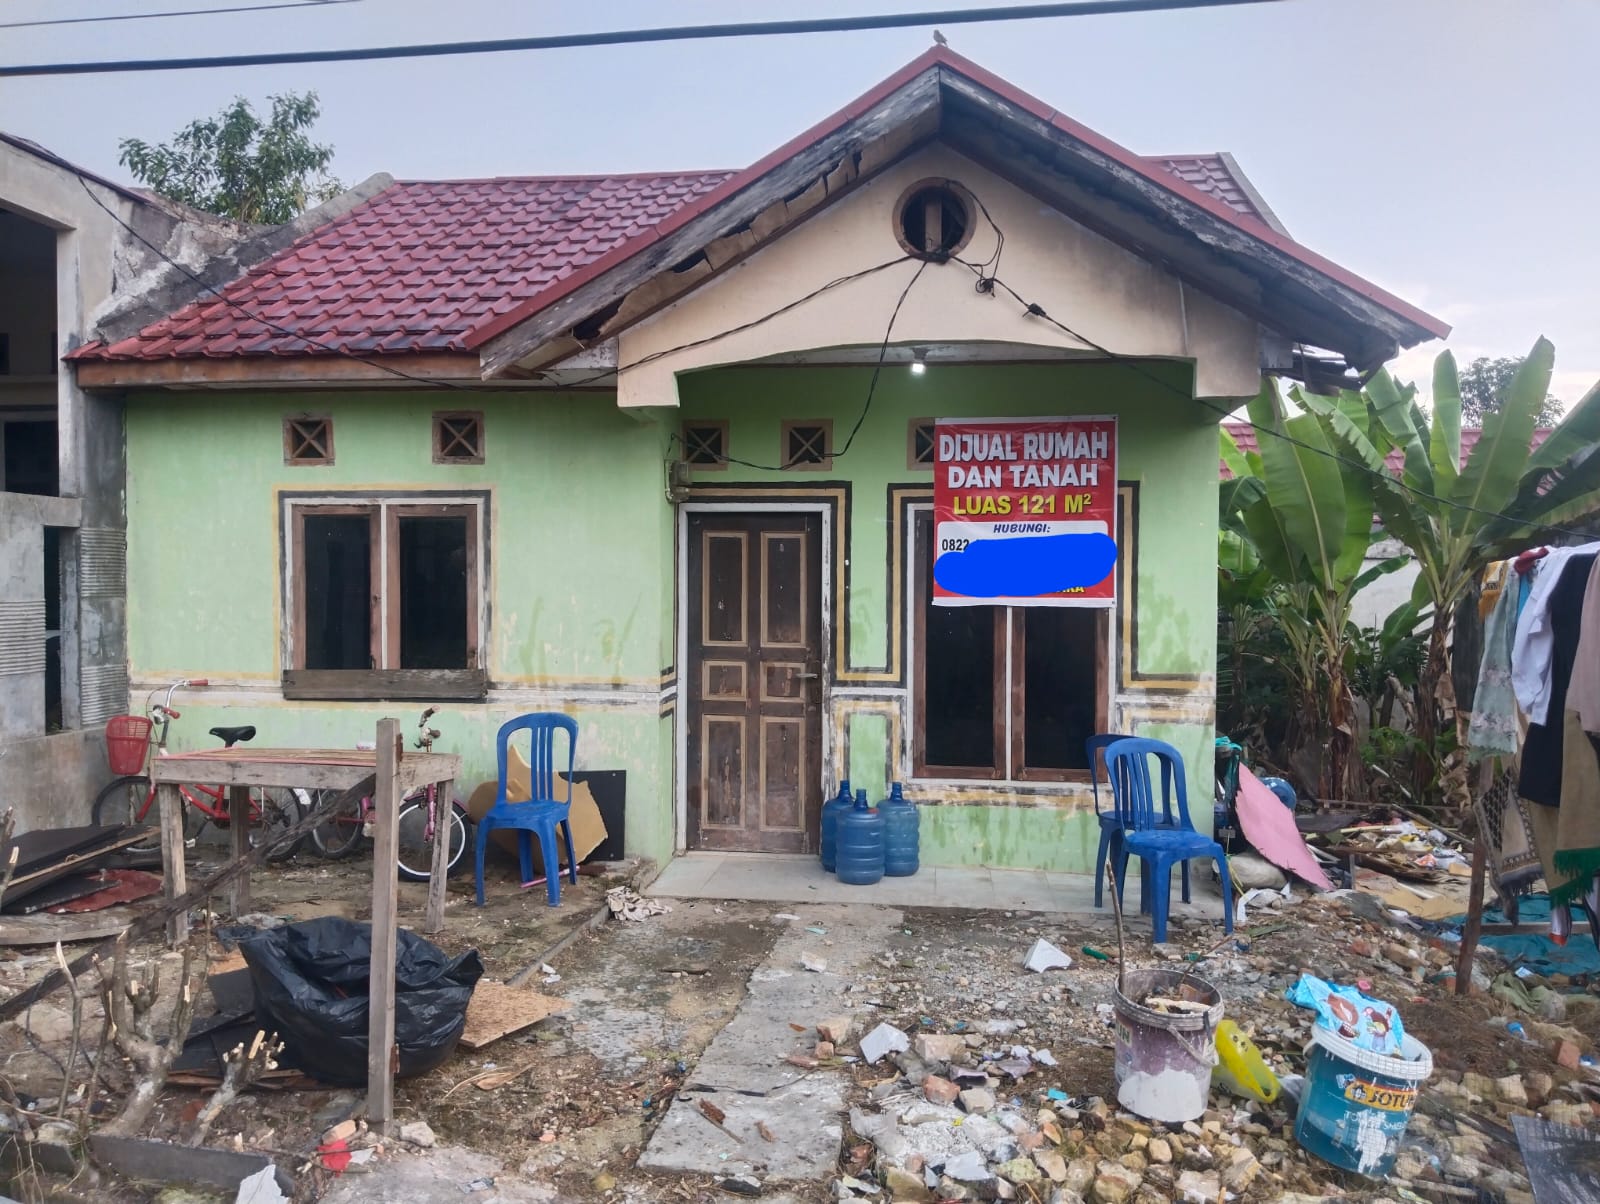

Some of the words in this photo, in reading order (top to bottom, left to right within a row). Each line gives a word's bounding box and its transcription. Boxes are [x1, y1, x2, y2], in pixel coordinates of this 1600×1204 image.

[939, 433, 1017, 462] DIJUAL
[1023, 431, 1108, 460] RUMAH
[948, 465, 1002, 489] DAN
[1009, 463, 1098, 488] TANAH
[953, 496, 1012, 515] LUAS
[1018, 494, 1056, 514] 121
[993, 523, 1051, 534] HUBUNGI:
